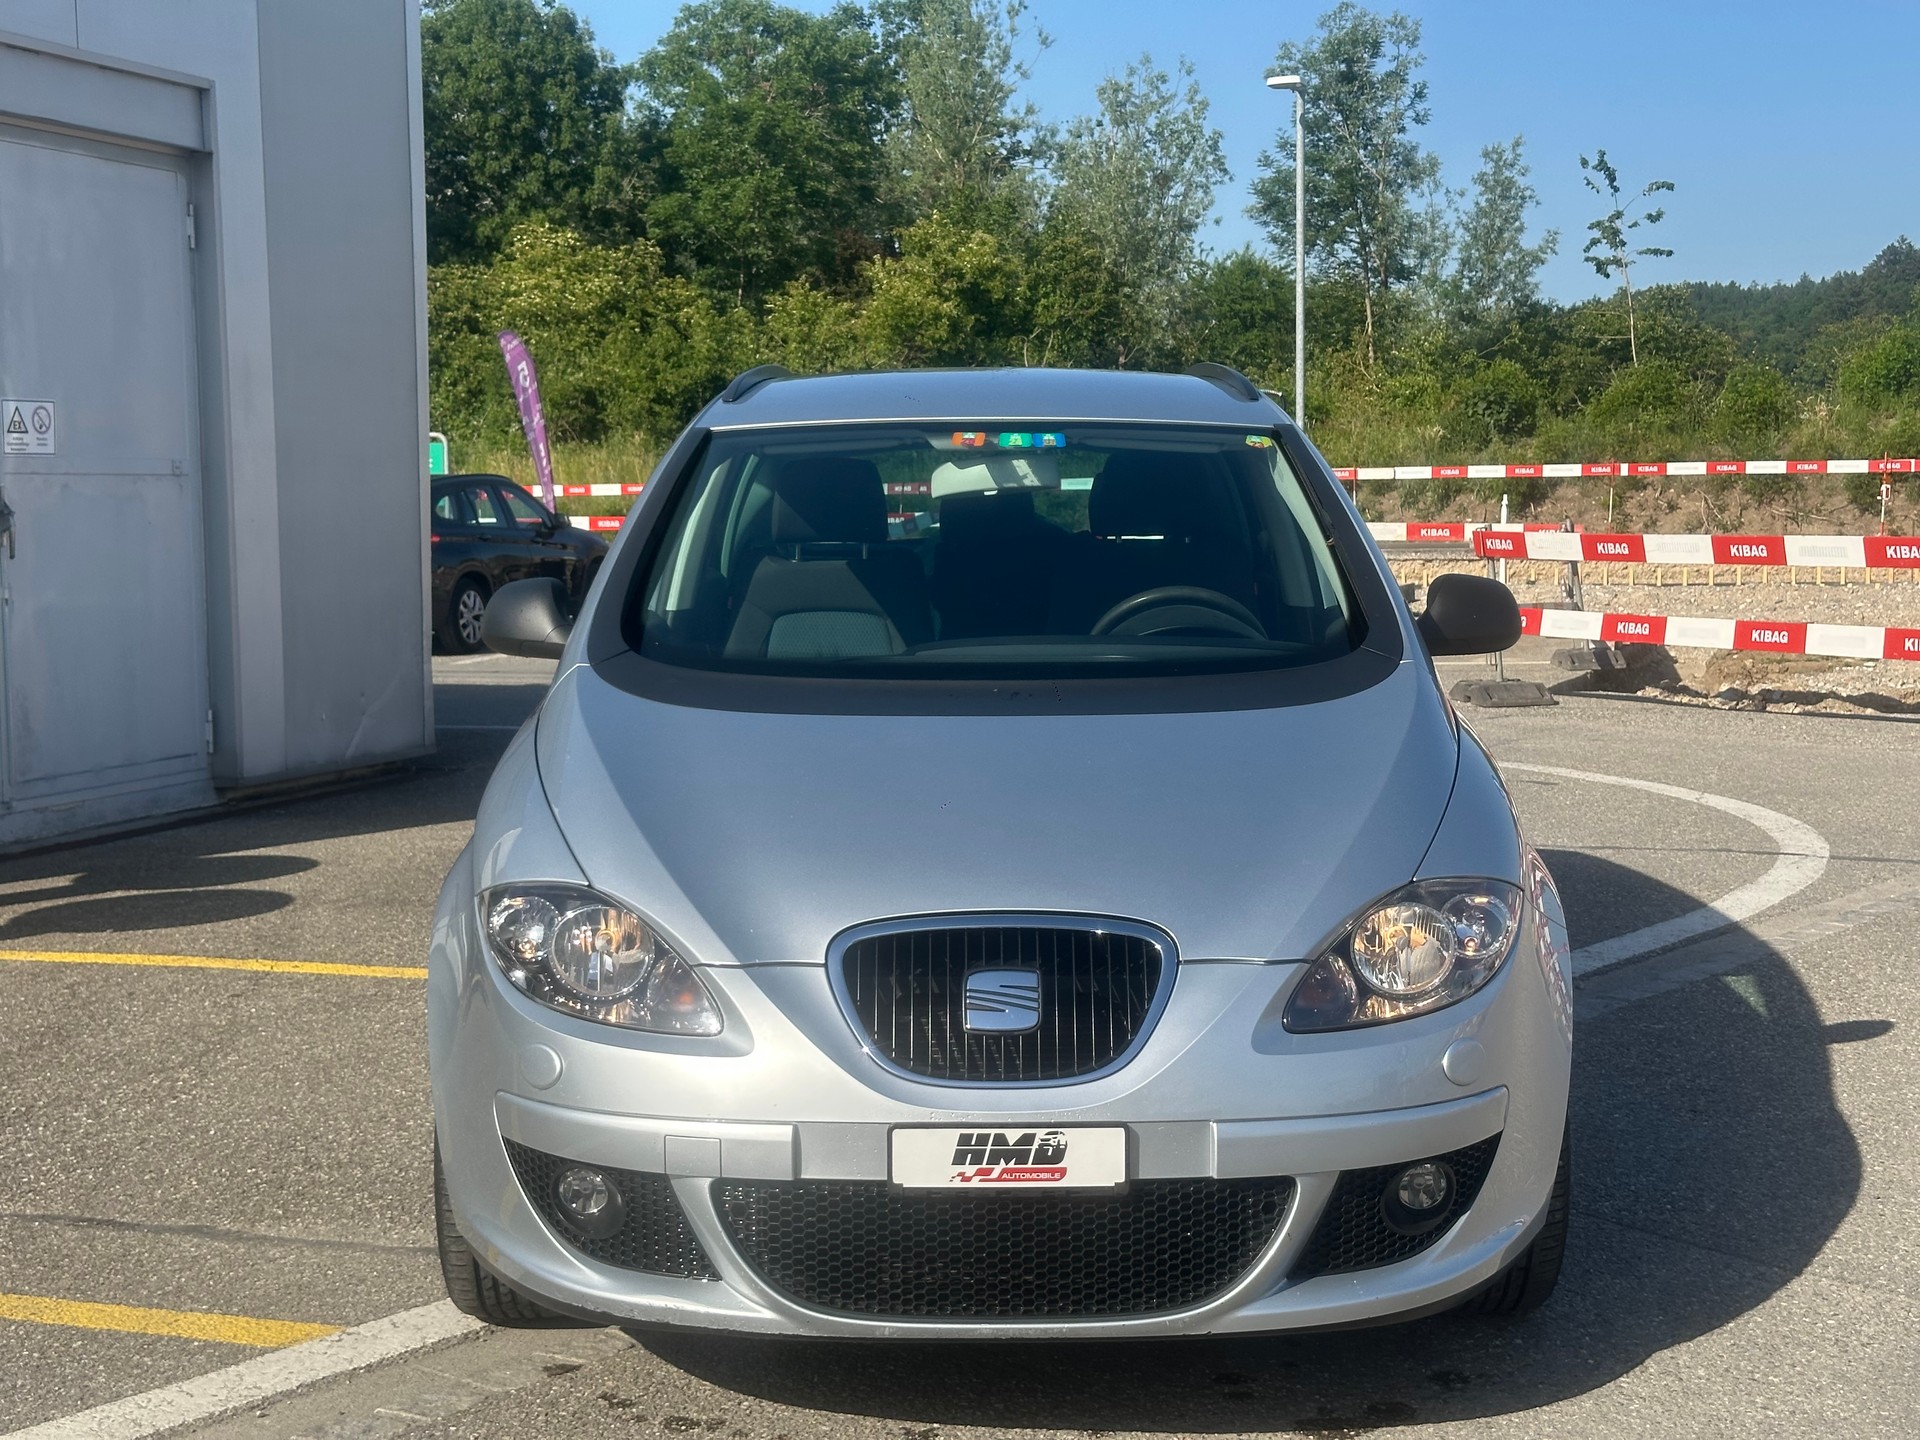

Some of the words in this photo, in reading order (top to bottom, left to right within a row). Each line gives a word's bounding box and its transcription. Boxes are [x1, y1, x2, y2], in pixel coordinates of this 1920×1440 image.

[1637, 465, 1658, 473] KIBAG
[1716, 464, 1737, 472] KIBAG
[1796, 463, 1818, 471] KIBAG
[1420, 527, 1450, 537] KIBAG
[1486, 538, 1514, 551] KIBAG
[1597, 542, 1630, 555] KIBAG
[1729, 544, 1768, 558] KIBAG
[1885, 545, 1920, 559] KIBA
[1616, 621, 1650, 635] KIBAG
[1751, 629, 1789, 644] KIBAG
